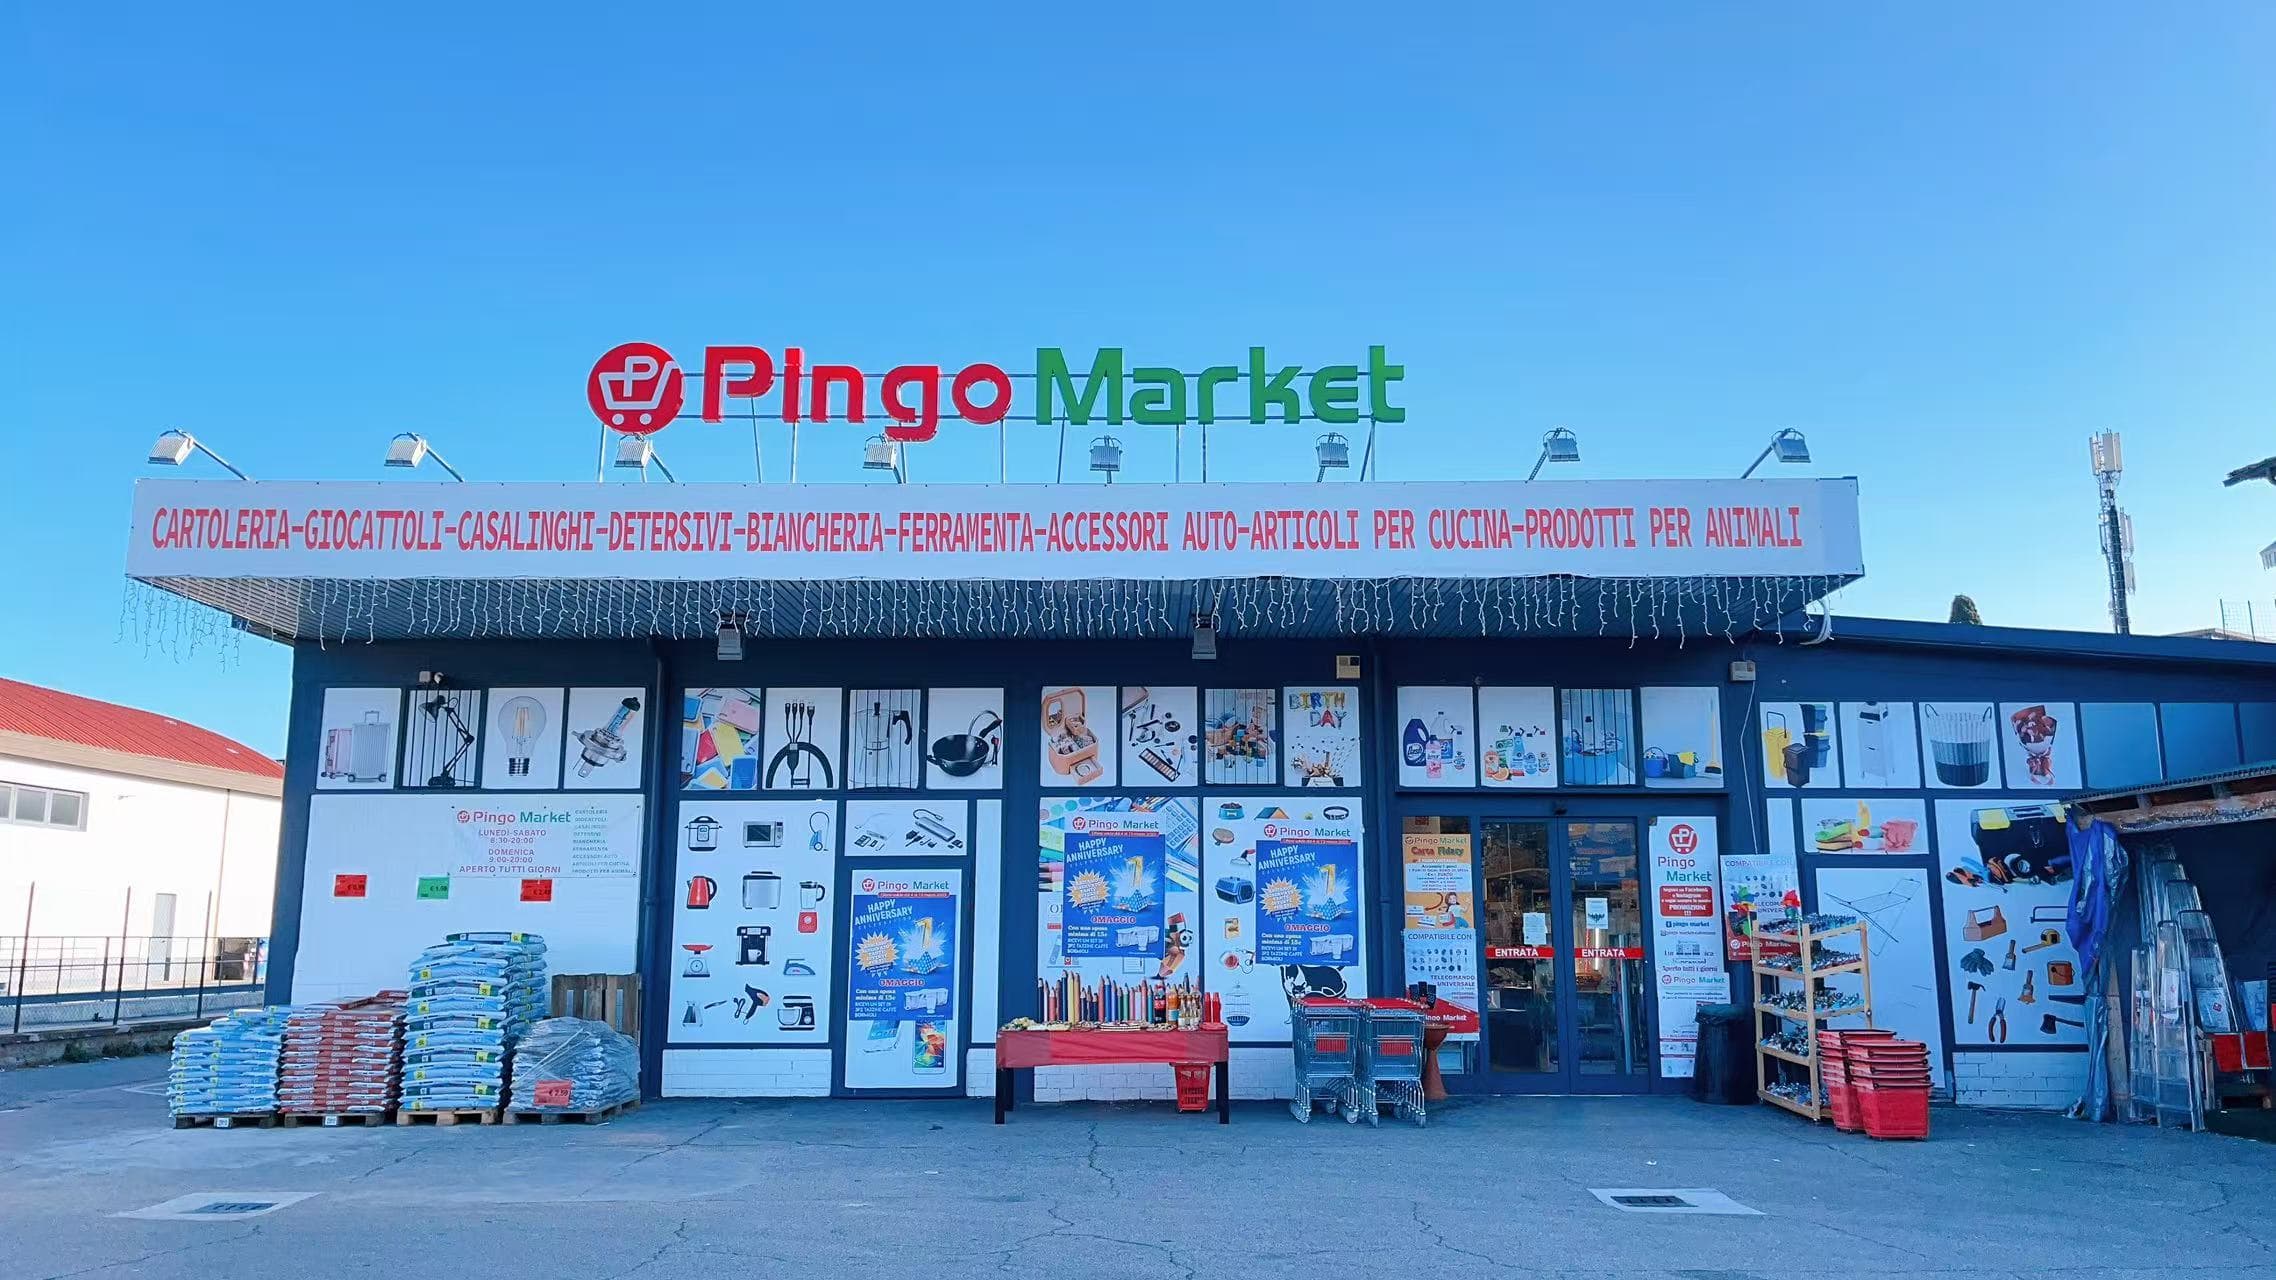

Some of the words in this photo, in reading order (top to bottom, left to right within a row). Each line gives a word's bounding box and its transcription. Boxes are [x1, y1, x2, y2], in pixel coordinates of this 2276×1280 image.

[701, 345, 1013, 442] Pingo
[1036, 344, 1406, 425] Market
[1374, 509, 1416, 549] PER
[1649, 507, 1693, 548] PER
[1705, 506, 1803, 547] ANIMALI
[1289, 691, 1346, 710] BIRTH
[1310, 710, 1348, 730] DAY
[473, 811, 516, 825] Pingo
[520, 811, 571, 823] Market
[1088, 819, 1119, 830] Pingo
[1123, 820, 1159, 829] Market
[1280, 827, 1310, 837] Pingo
[1314, 828, 1351, 837] Market
[1078, 837, 1107, 851] HAPPY
[1414, 836, 1439, 845] Pingo
[488, 848, 535, 856] DOMENICA
[1066, 844, 1123, 864] ANNIVERSARY
[1270, 844, 1299, 859] HAPPY
[1258, 852, 1316, 871] ANNIVERSARY
[1657, 856, 1696, 870] Pingo
[1666, 870, 1713, 882] Market
[877, 880, 909, 891] Pingo
[912, 881, 950, 890] Market
[867, 898, 896, 914] HAPPY
[854, 905, 913, 926] ANNIVERSARY
[1495, 948, 1539, 957] ENTRATA
[1581, 949, 1626, 957] ENTRATA
